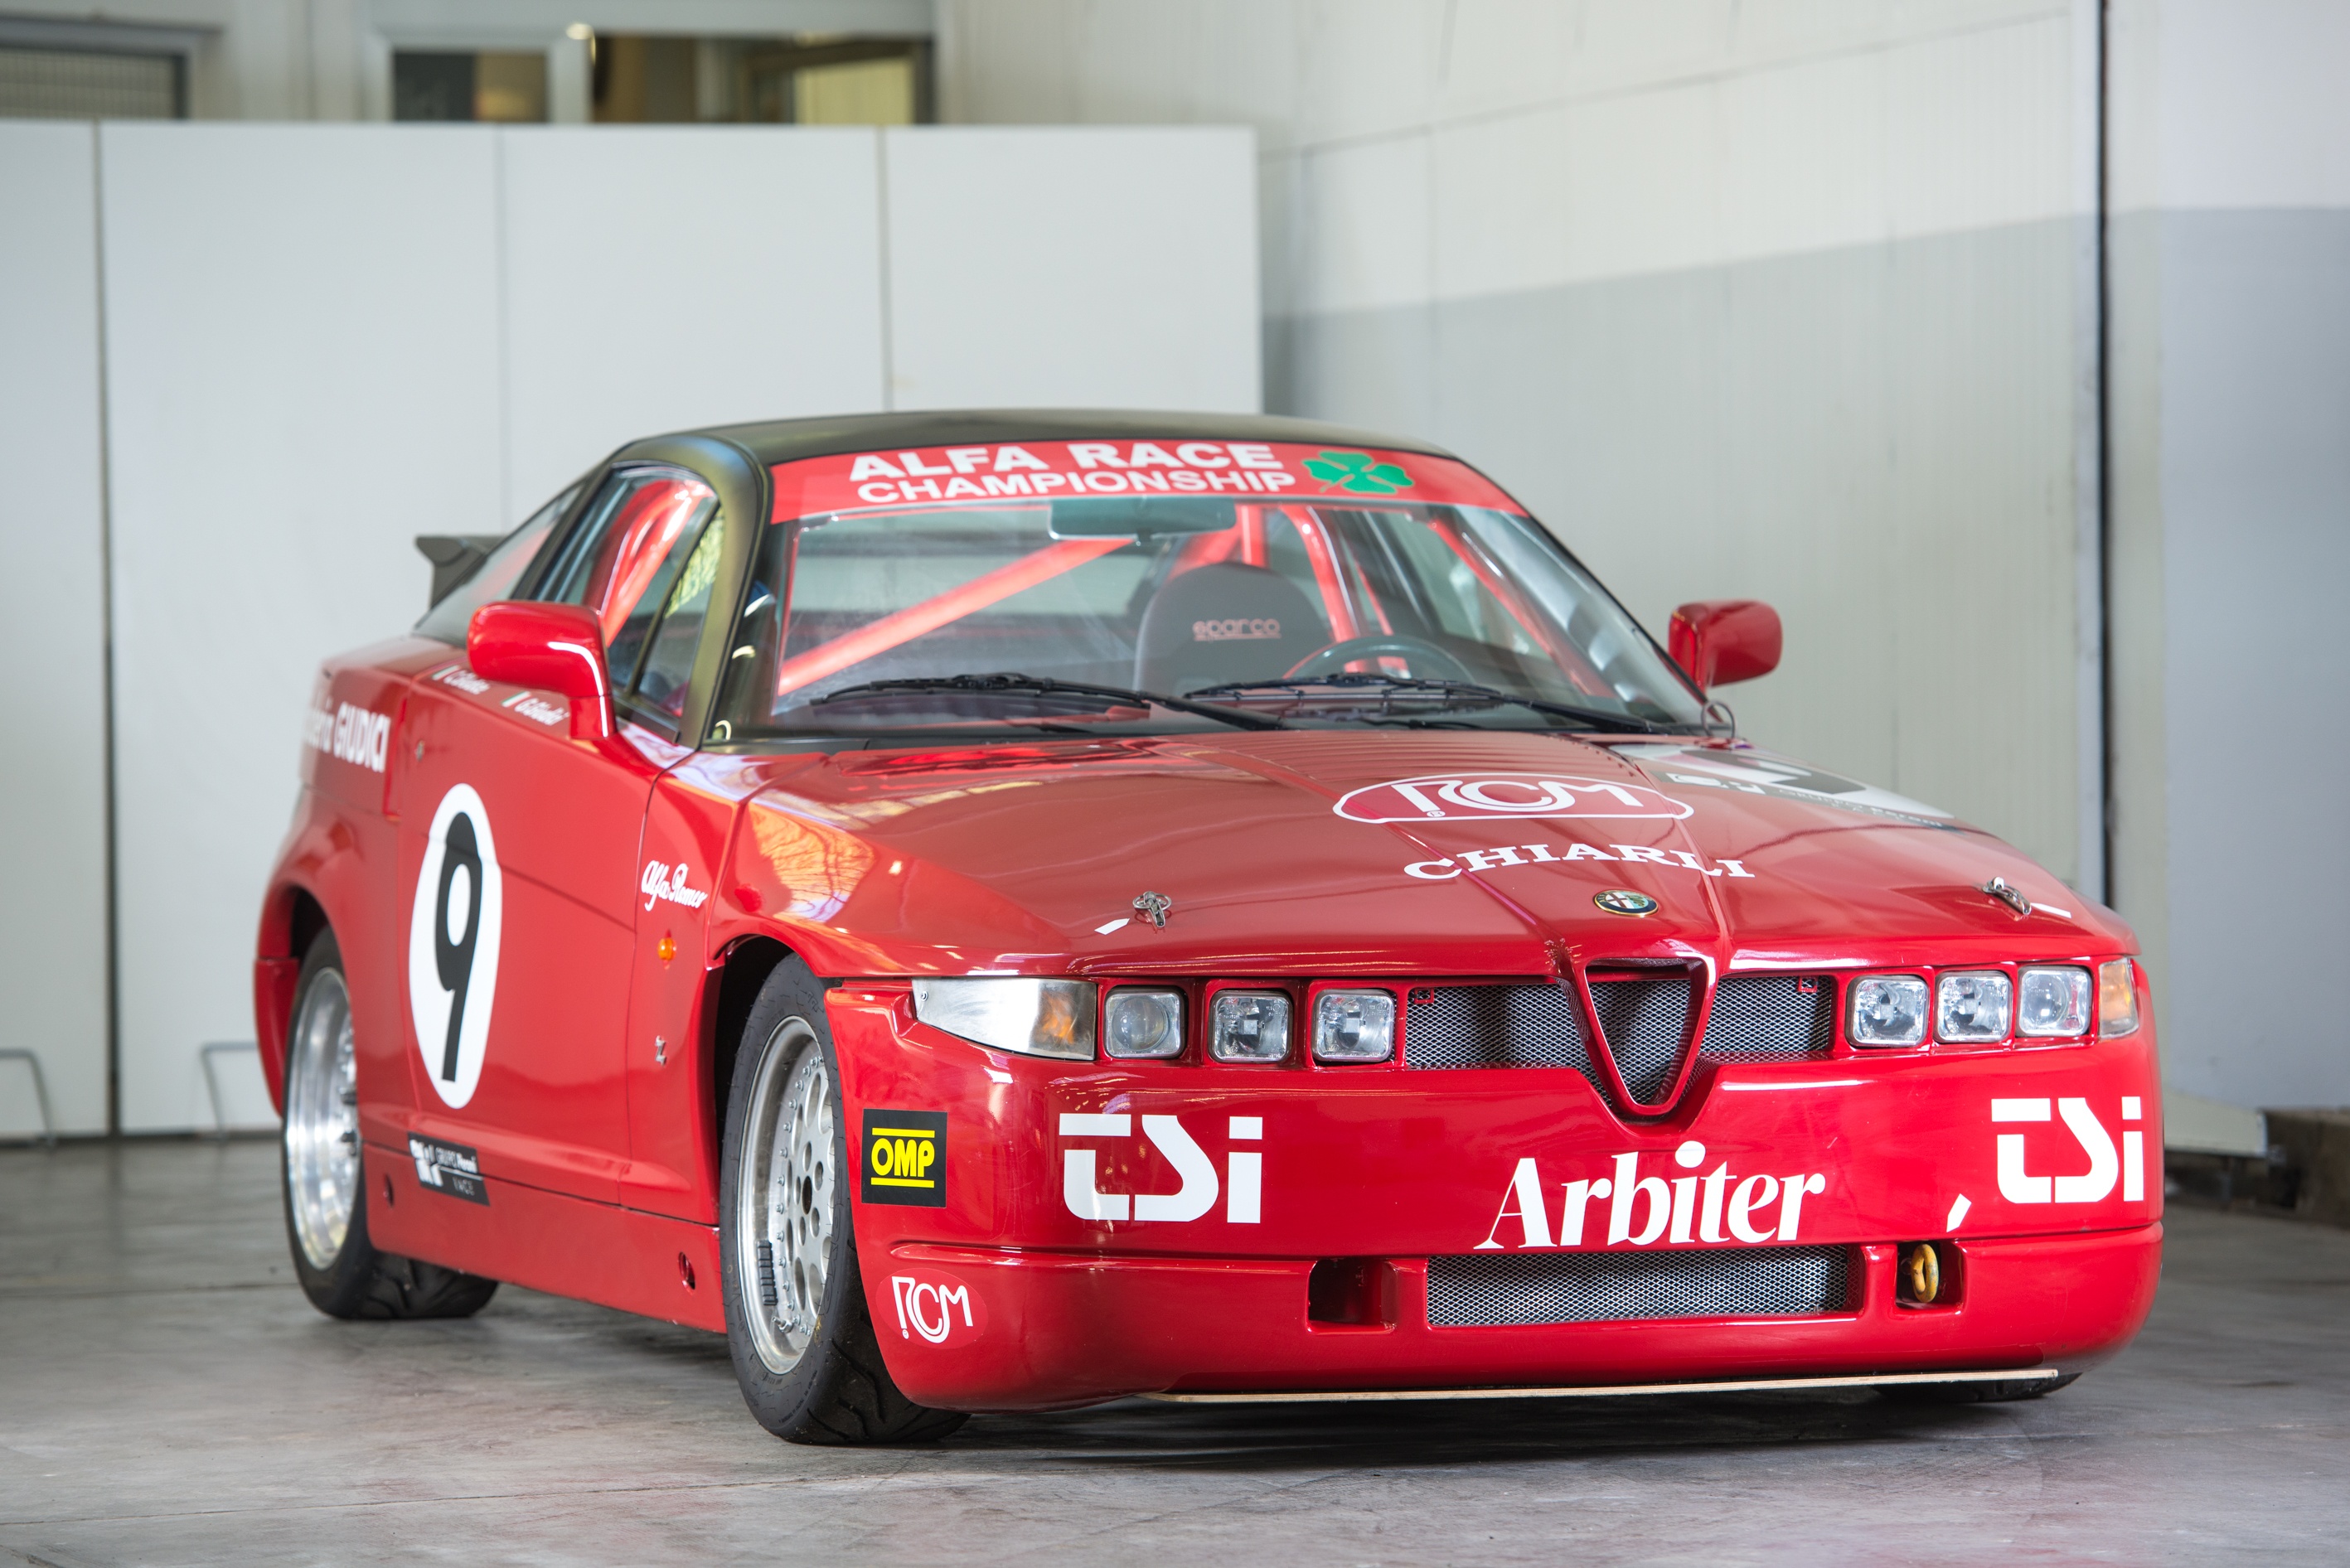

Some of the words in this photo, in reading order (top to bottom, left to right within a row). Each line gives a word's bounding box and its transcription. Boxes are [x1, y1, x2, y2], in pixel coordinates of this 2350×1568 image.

[850, 446, 1049, 482] ALFA
[1068, 443, 1284, 470] RACE
[857, 470, 1296, 503] CHAMPIONSHIP
[1403, 843, 1755, 880] CHIARLI
[435, 811, 482, 1082] 9
[871, 1138, 935, 1178] OMP
[1473, 1140, 1826, 1250] Arbiter
